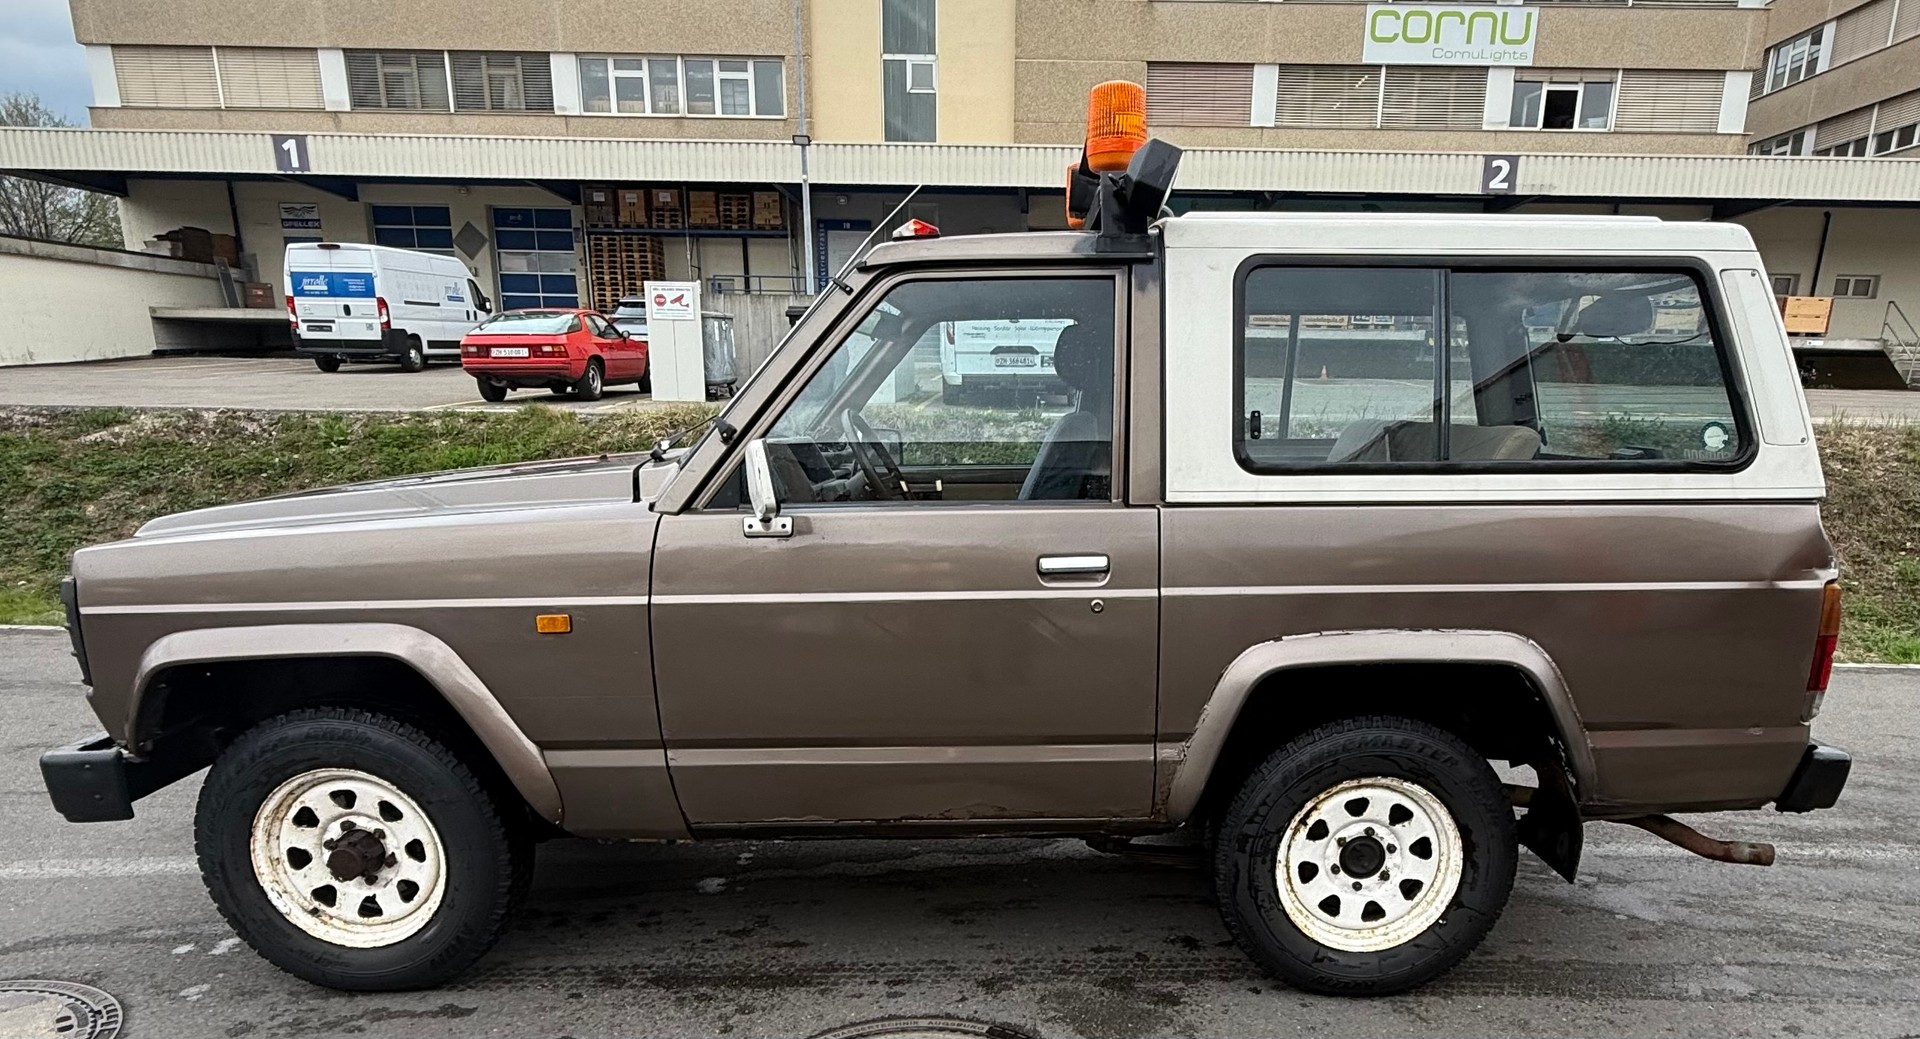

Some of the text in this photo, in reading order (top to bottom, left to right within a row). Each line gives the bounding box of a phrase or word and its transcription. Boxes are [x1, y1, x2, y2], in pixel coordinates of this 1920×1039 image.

[1370, 9, 1533, 46] cornu
[1432, 48, 1528, 62] CornuLights
[281, 138, 300, 168] 1
[1489, 158, 1511, 189] 2
